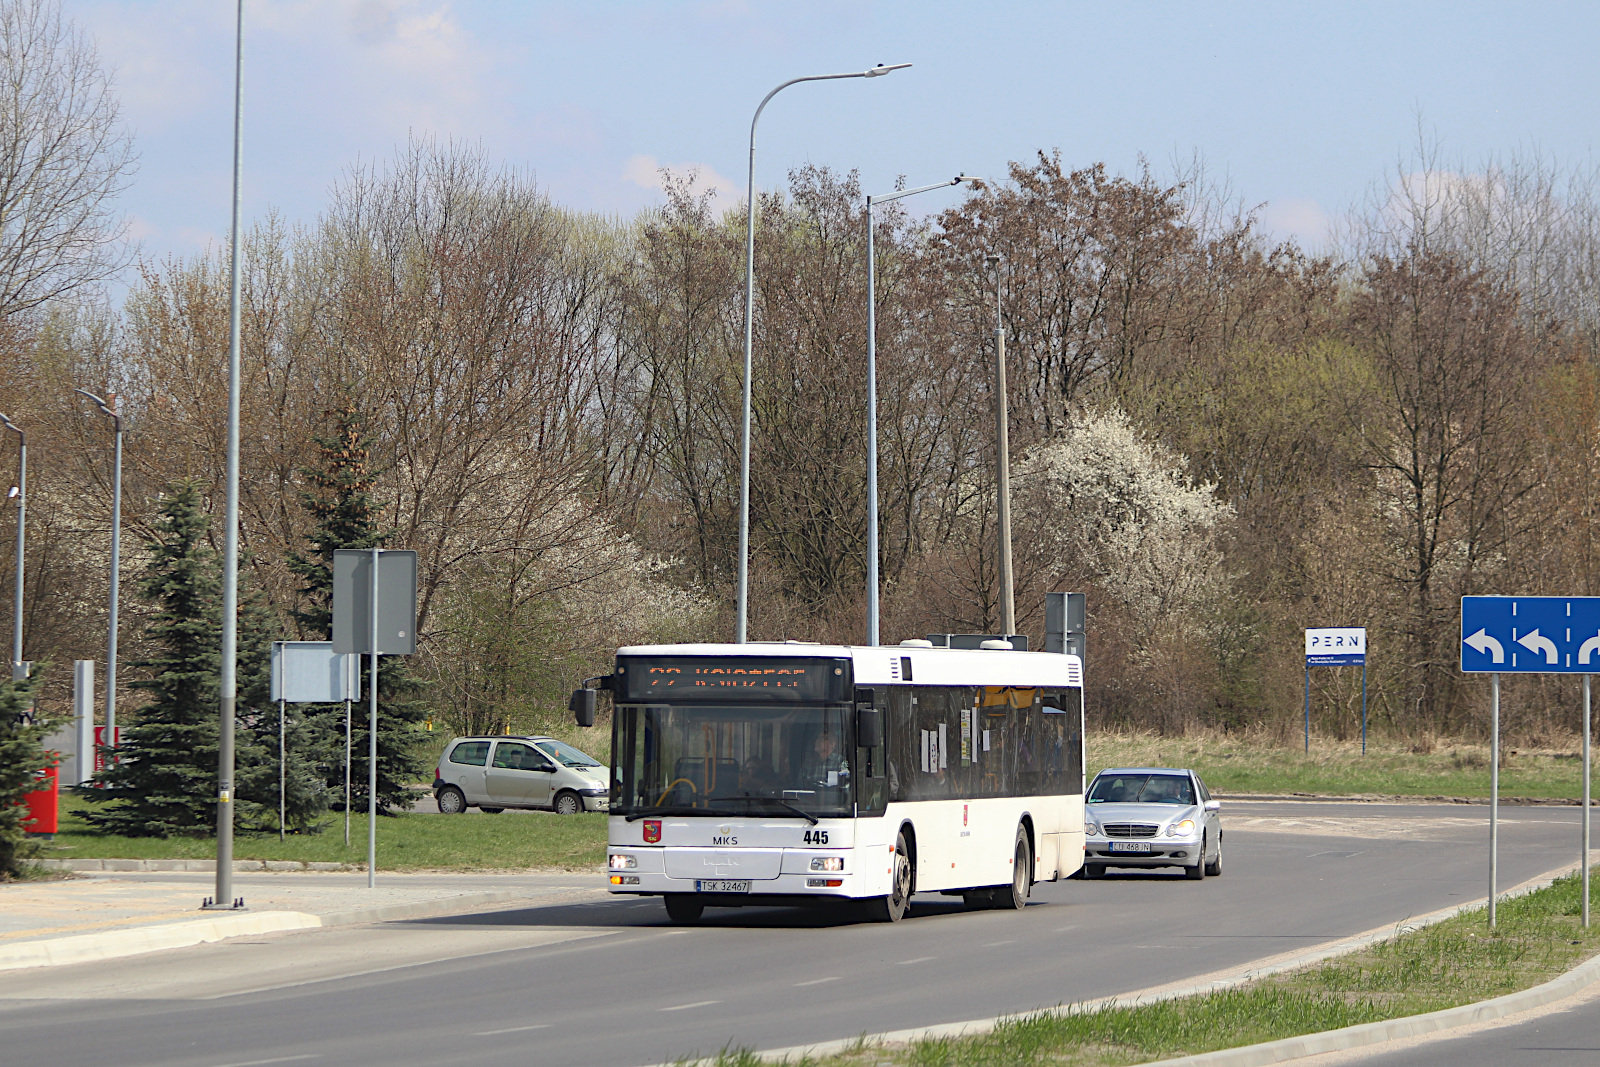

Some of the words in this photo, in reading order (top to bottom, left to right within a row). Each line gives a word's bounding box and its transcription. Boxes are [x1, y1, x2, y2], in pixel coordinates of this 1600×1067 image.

[1312, 636, 1358, 647] PERN
[713, 836, 738, 845] MKS
[803, 831, 829, 845] 445
[702, 881, 718, 891] TSK
[720, 881, 747, 891] 32467
